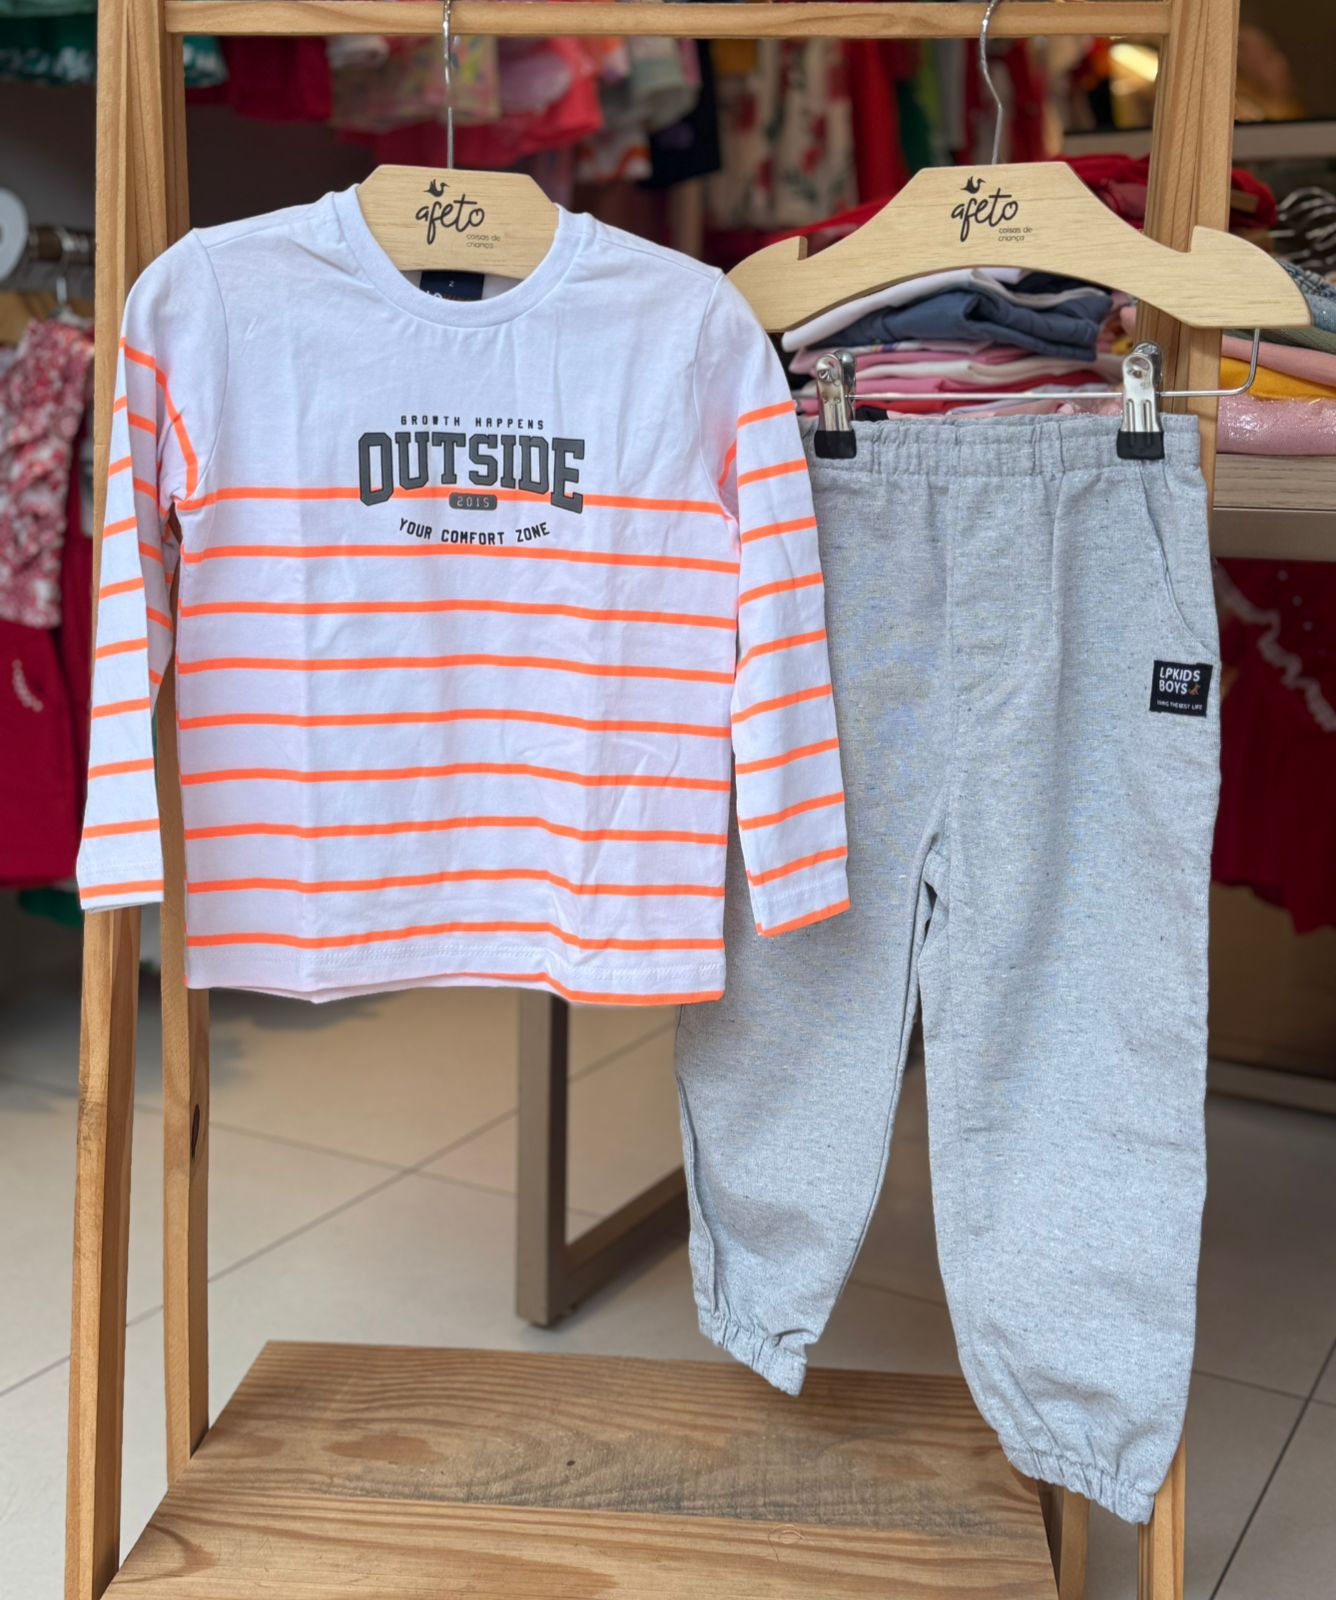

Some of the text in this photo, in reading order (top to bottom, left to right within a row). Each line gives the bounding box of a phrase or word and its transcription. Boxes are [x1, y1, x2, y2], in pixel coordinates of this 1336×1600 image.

[415, 194, 485, 245] afeto
[951, 188, 1018, 242] afeto
[1023, 225, 1032, 233] de
[401, 415, 544, 430] GROWTH HAPPENS
[358, 431, 585, 514] OUTSIDE
[456, 495, 490, 508] 2015
[399, 518, 550, 545] YOUR COMFORT ZONE
[1159, 666, 1201, 682] LPKIDS
[1159, 680, 1188, 695] BOYS
